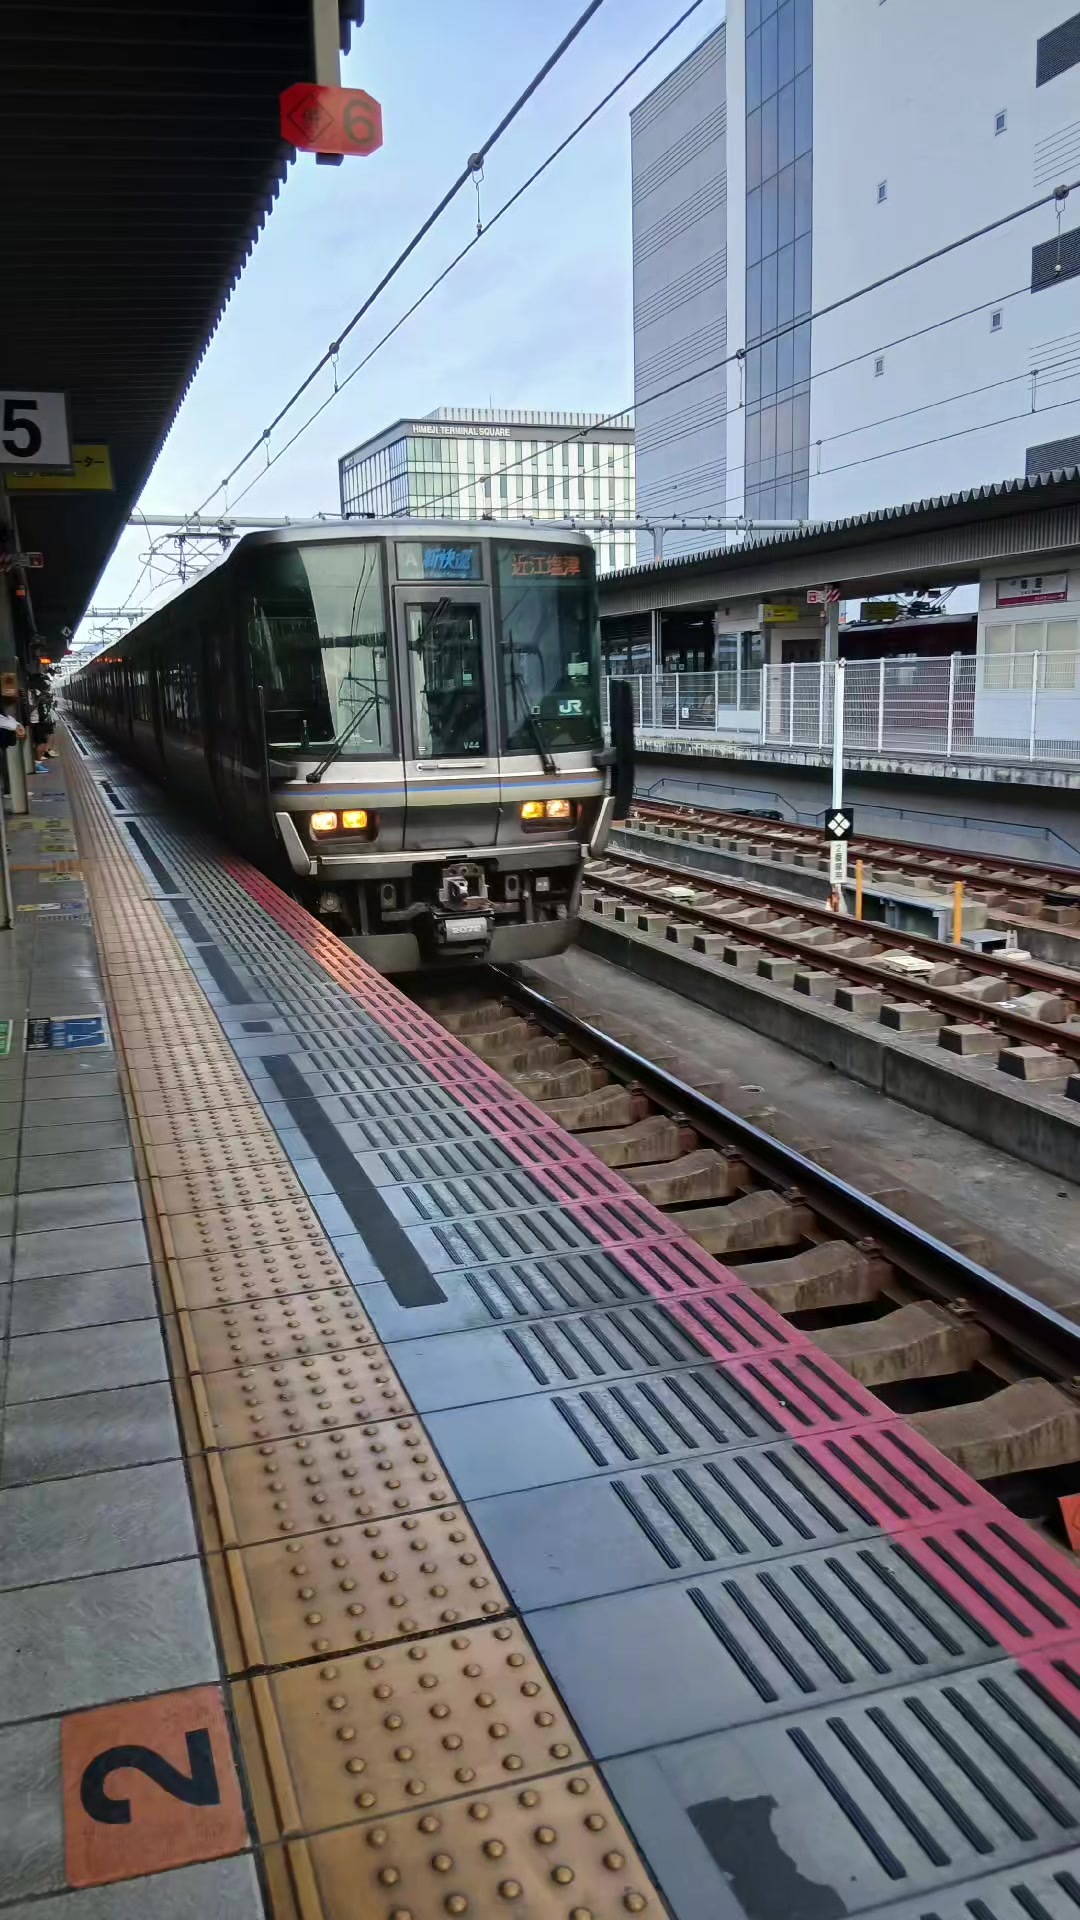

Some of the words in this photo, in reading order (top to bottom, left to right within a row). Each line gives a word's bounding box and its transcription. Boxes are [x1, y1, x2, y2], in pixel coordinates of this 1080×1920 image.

[343, 98, 376, 146] 6
[3, 399, 42, 458] 5
[412, 424, 438, 434] HIMEJI
[440, 426, 478, 436] TERMINAL
[479, 427, 511, 437] SQUARE
[559, 699, 582, 713] JR
[80, 1727, 221, 1825] 2
